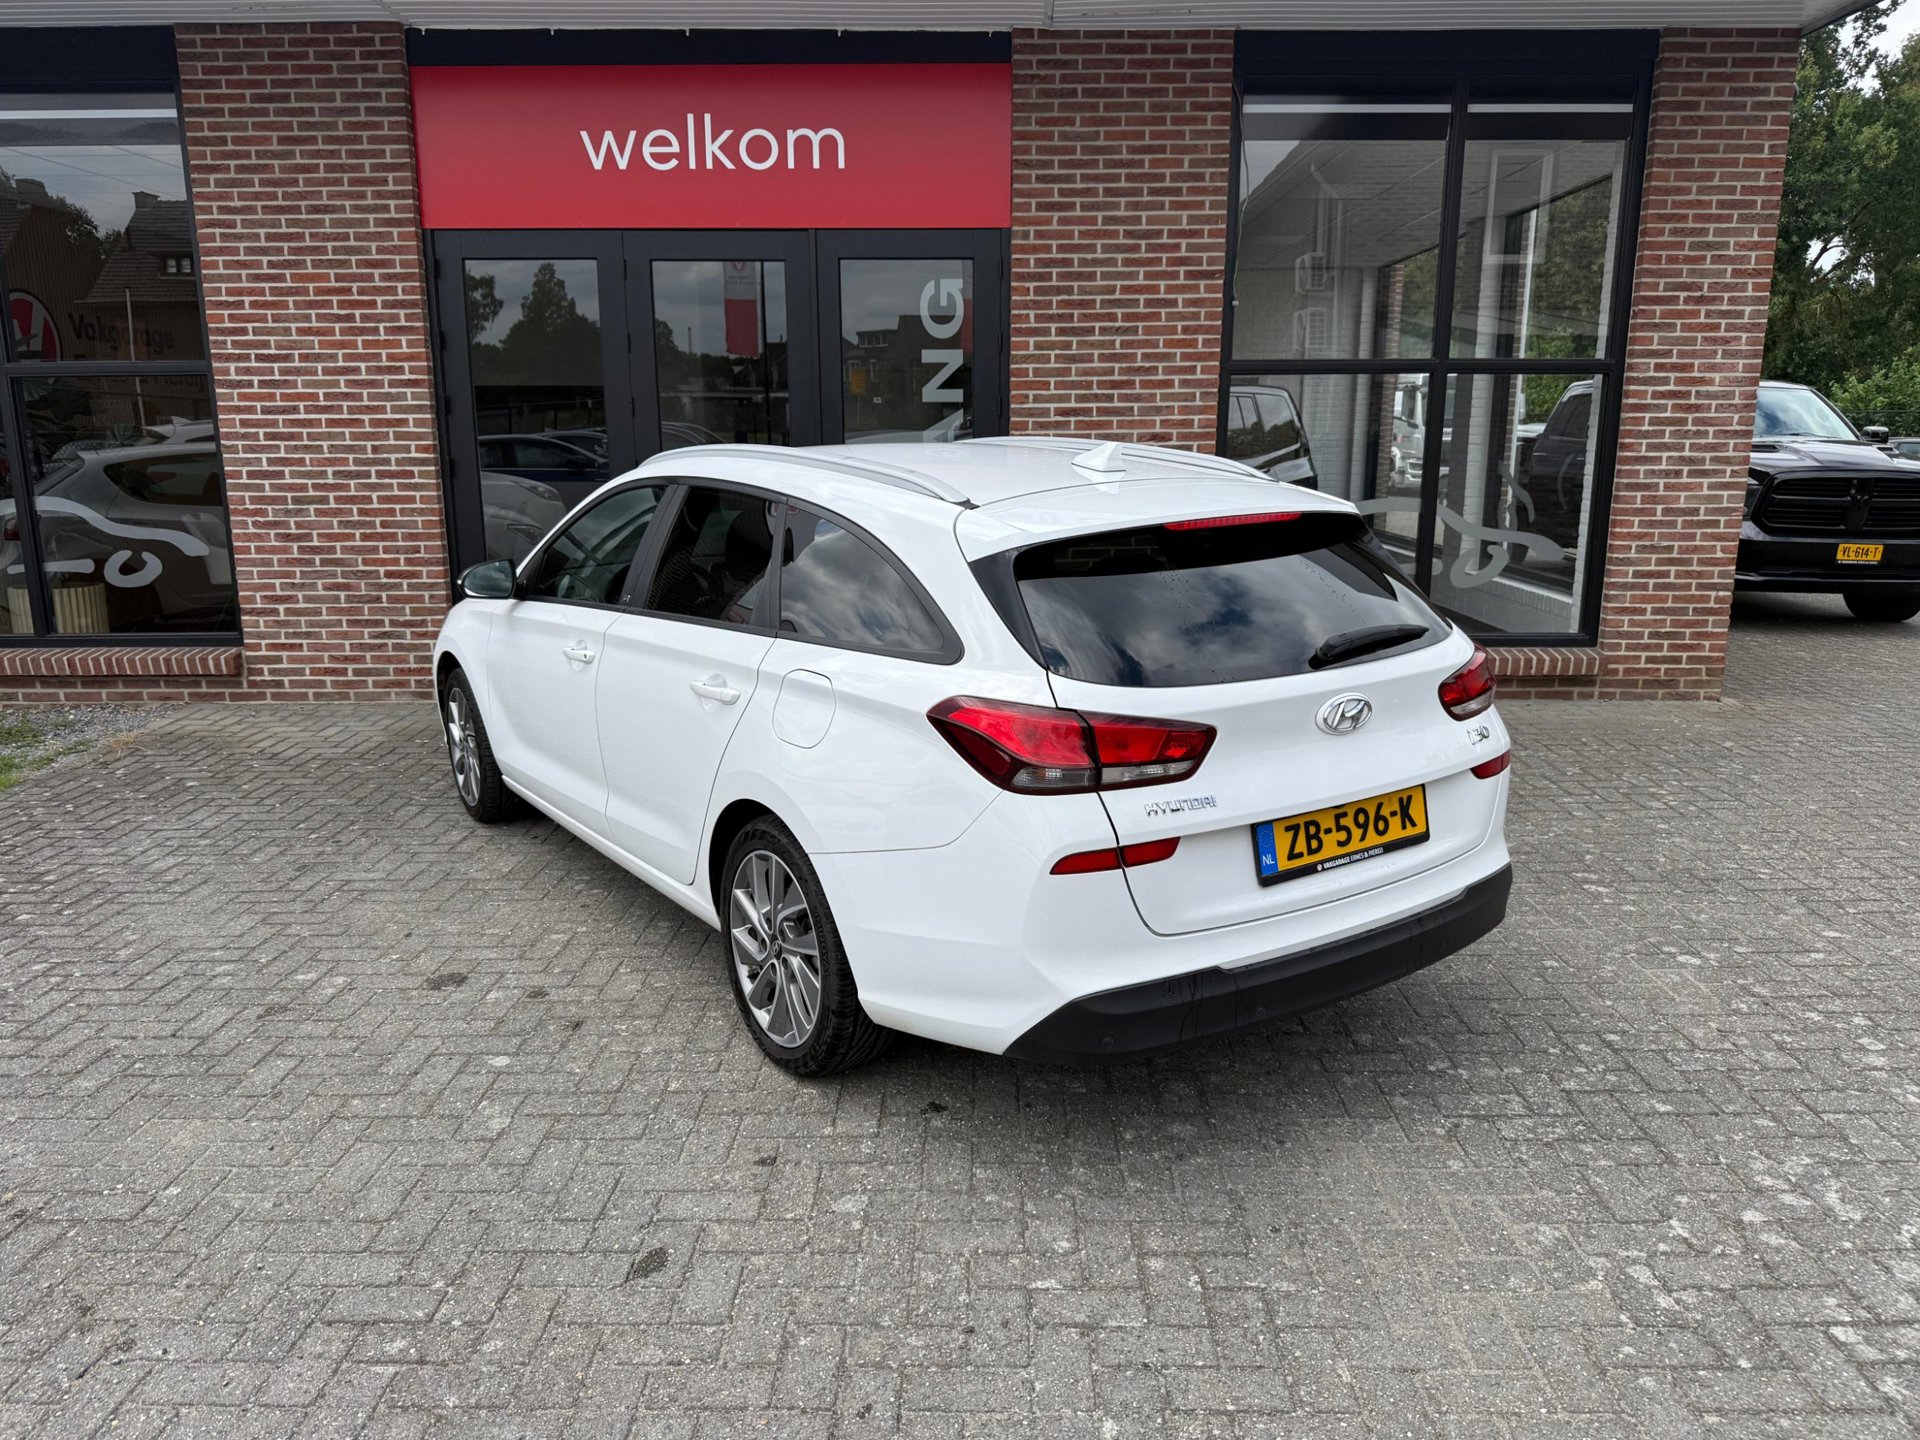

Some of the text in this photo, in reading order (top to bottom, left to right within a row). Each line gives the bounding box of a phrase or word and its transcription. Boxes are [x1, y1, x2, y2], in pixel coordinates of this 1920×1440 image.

[579, 112, 846, 171] welkom
[1144, 794, 1217, 817] HYUNDAI
[1284, 794, 1418, 861] ZB-596-K
[1262, 855, 1276, 867] NL
[1323, 856, 1350, 869] VAKGARAGE
